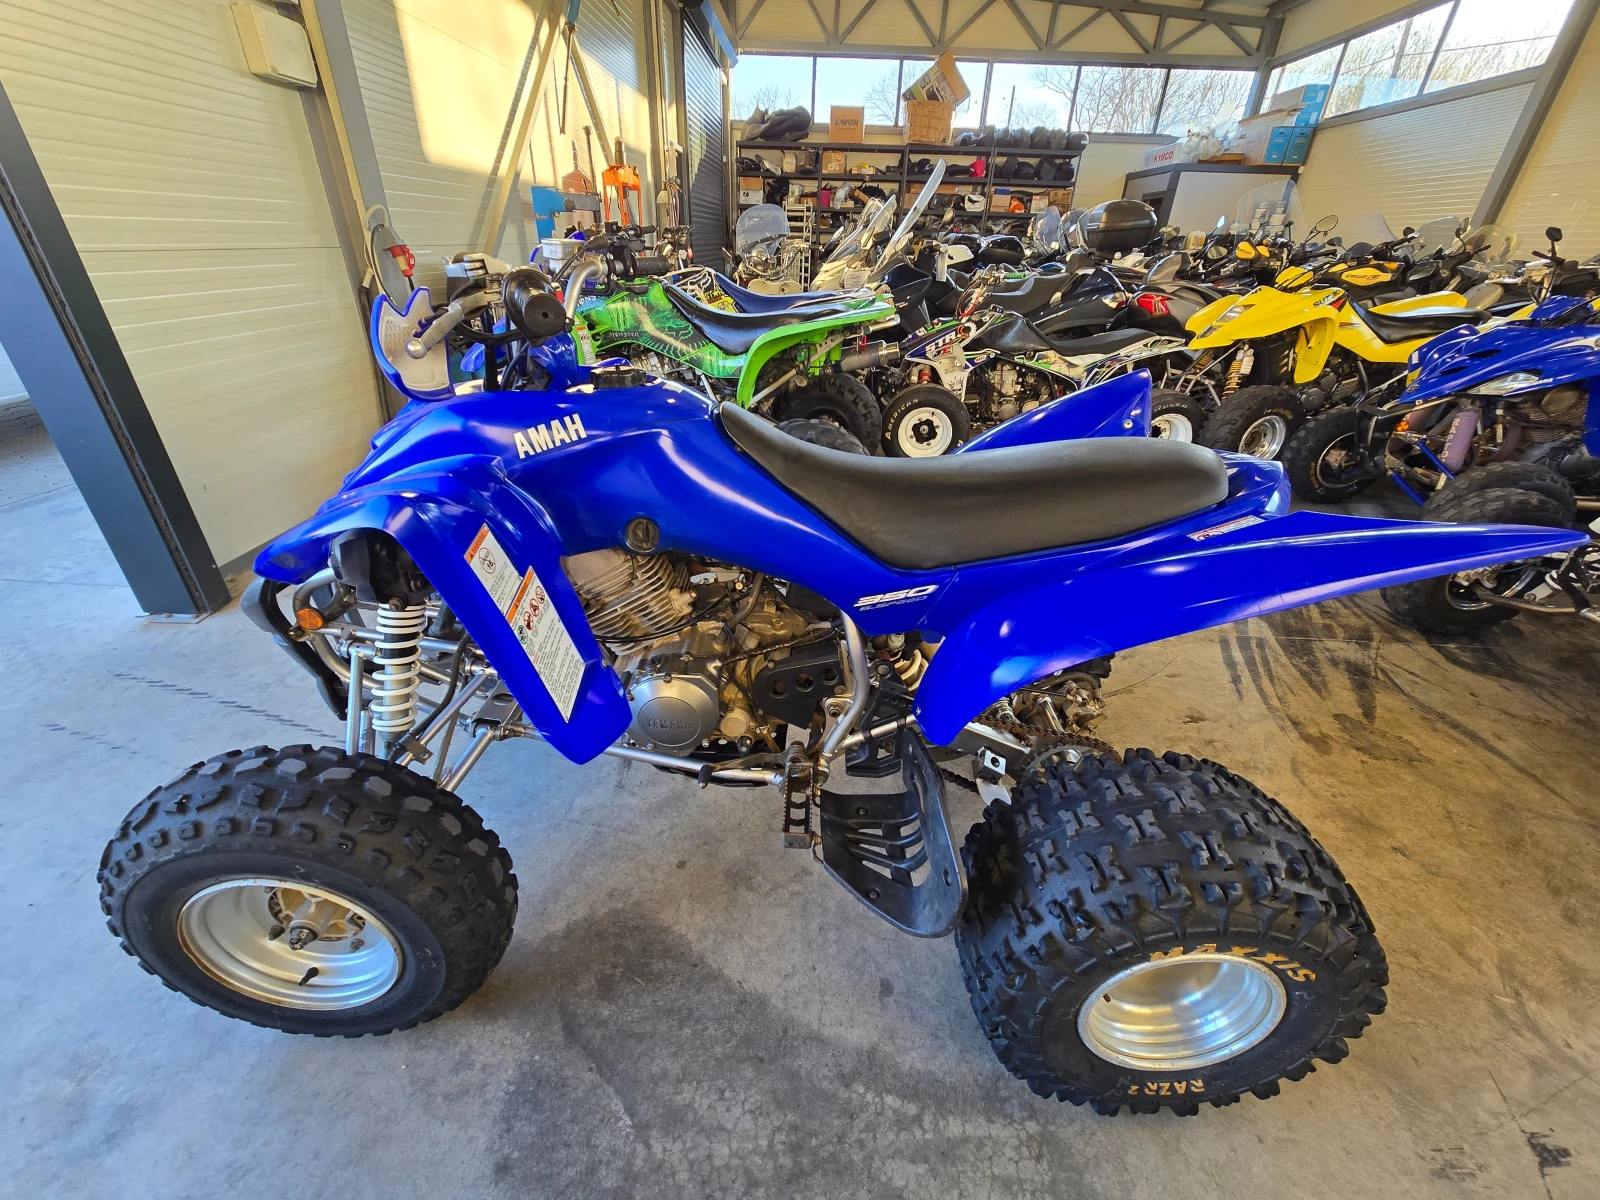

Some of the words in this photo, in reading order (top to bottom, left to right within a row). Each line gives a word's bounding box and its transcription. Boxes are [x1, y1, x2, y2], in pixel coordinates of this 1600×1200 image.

[834, 118, 860, 126] LAVOR
[1152, 150, 1174, 163] KYMCO
[1313, 289, 1341, 308] SUZUKI
[885, 397, 919, 440] AMERICAN
[513, 413, 587, 459] AMAH
[853, 584, 939, 607] 350
[645, 717, 692, 730] YAMAHA
[1149, 943, 1317, 982] MAXXIS
[1144, 1078, 1206, 1096] RAZR
